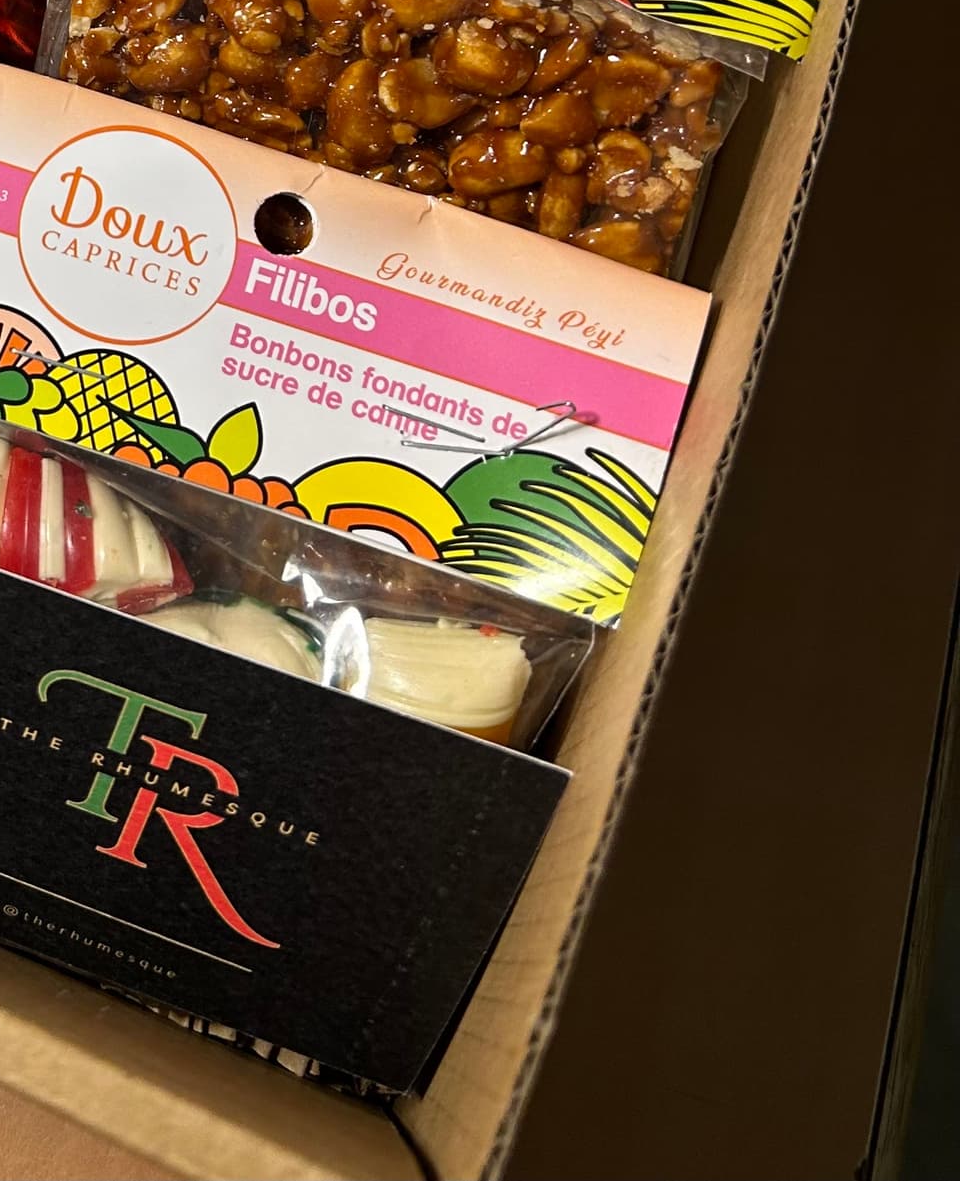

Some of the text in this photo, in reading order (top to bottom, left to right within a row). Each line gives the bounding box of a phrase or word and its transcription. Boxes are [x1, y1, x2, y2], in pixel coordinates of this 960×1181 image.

[51, 166, 209, 267] Doux
[41, 229, 202, 297] CAPRICES
[244, 258, 378, 332] Filibos
[376, 252, 626, 351] Gourmandiz Péyi
[221, 356, 439, 441] sucre de canne
[229, 322, 528, 440] Bonbons fondants de
[0, 717, 321, 846] THE RHUMESQUE
[2, 903, 178, 980] @therhumesque
